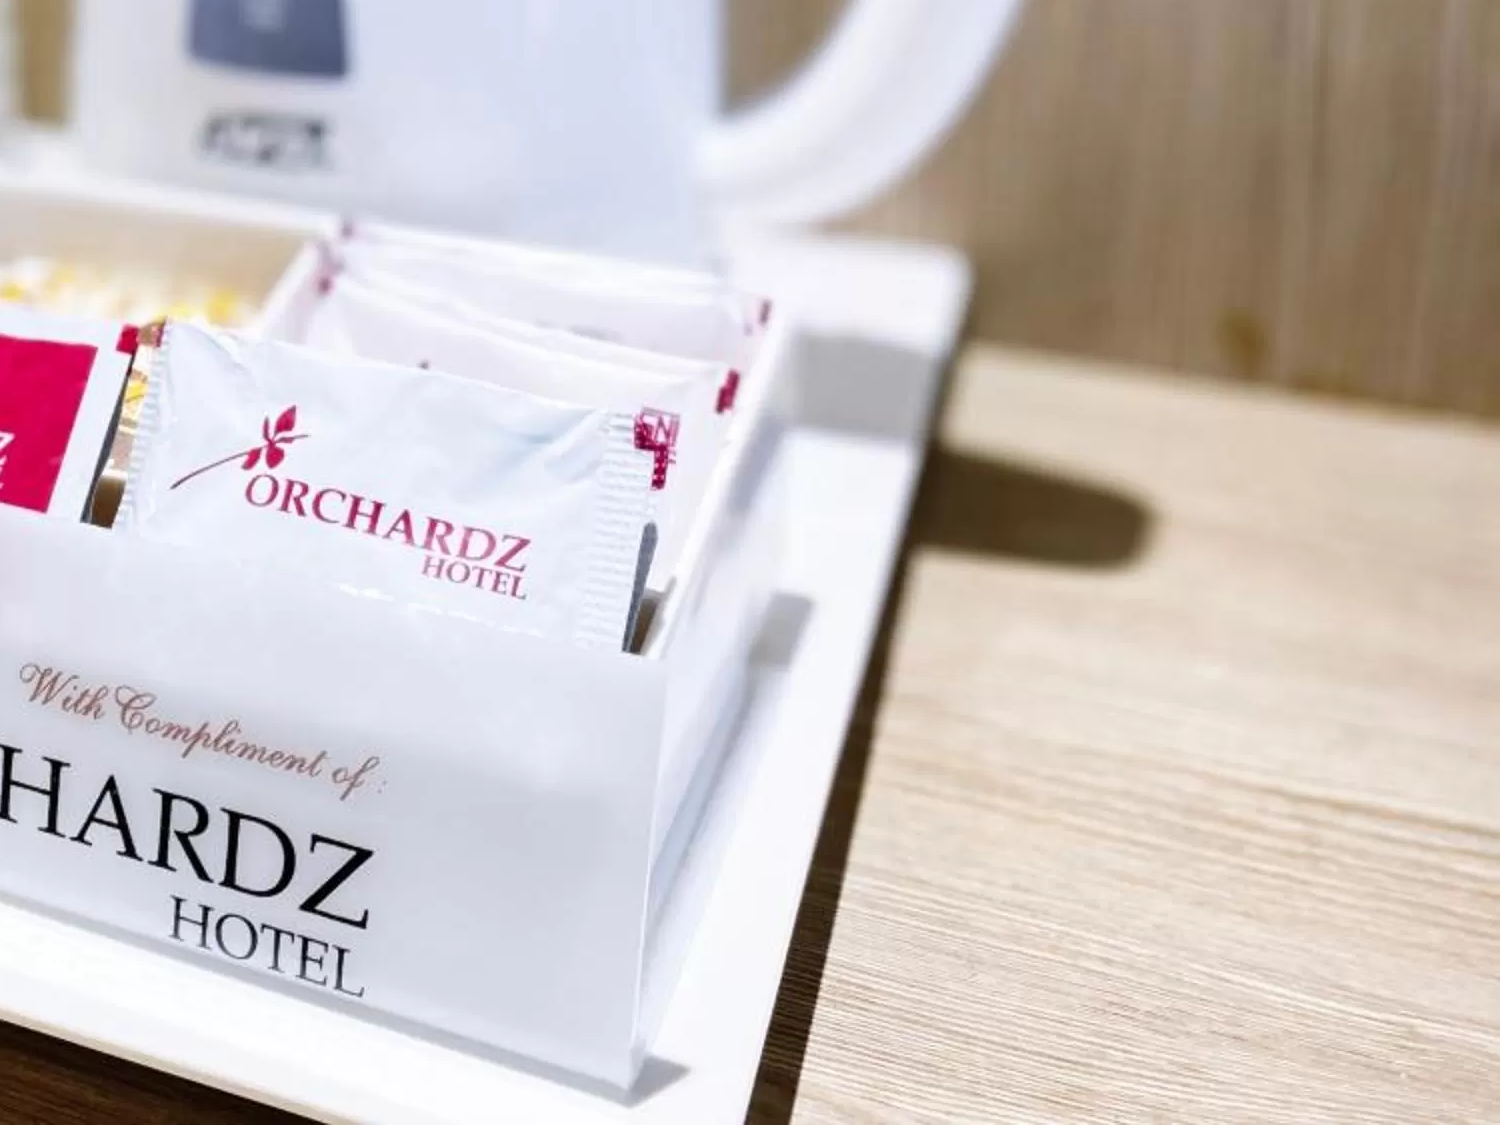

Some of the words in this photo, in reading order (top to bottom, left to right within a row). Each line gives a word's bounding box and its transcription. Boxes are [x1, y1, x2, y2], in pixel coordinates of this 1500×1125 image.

[245, 473, 531, 572] ORCHARDZ
[421, 555, 527, 600] HOTEL
[19, 663, 106, 720] With
[115, 684, 327, 779] Compliment
[169, 895, 366, 997] HOTEL
